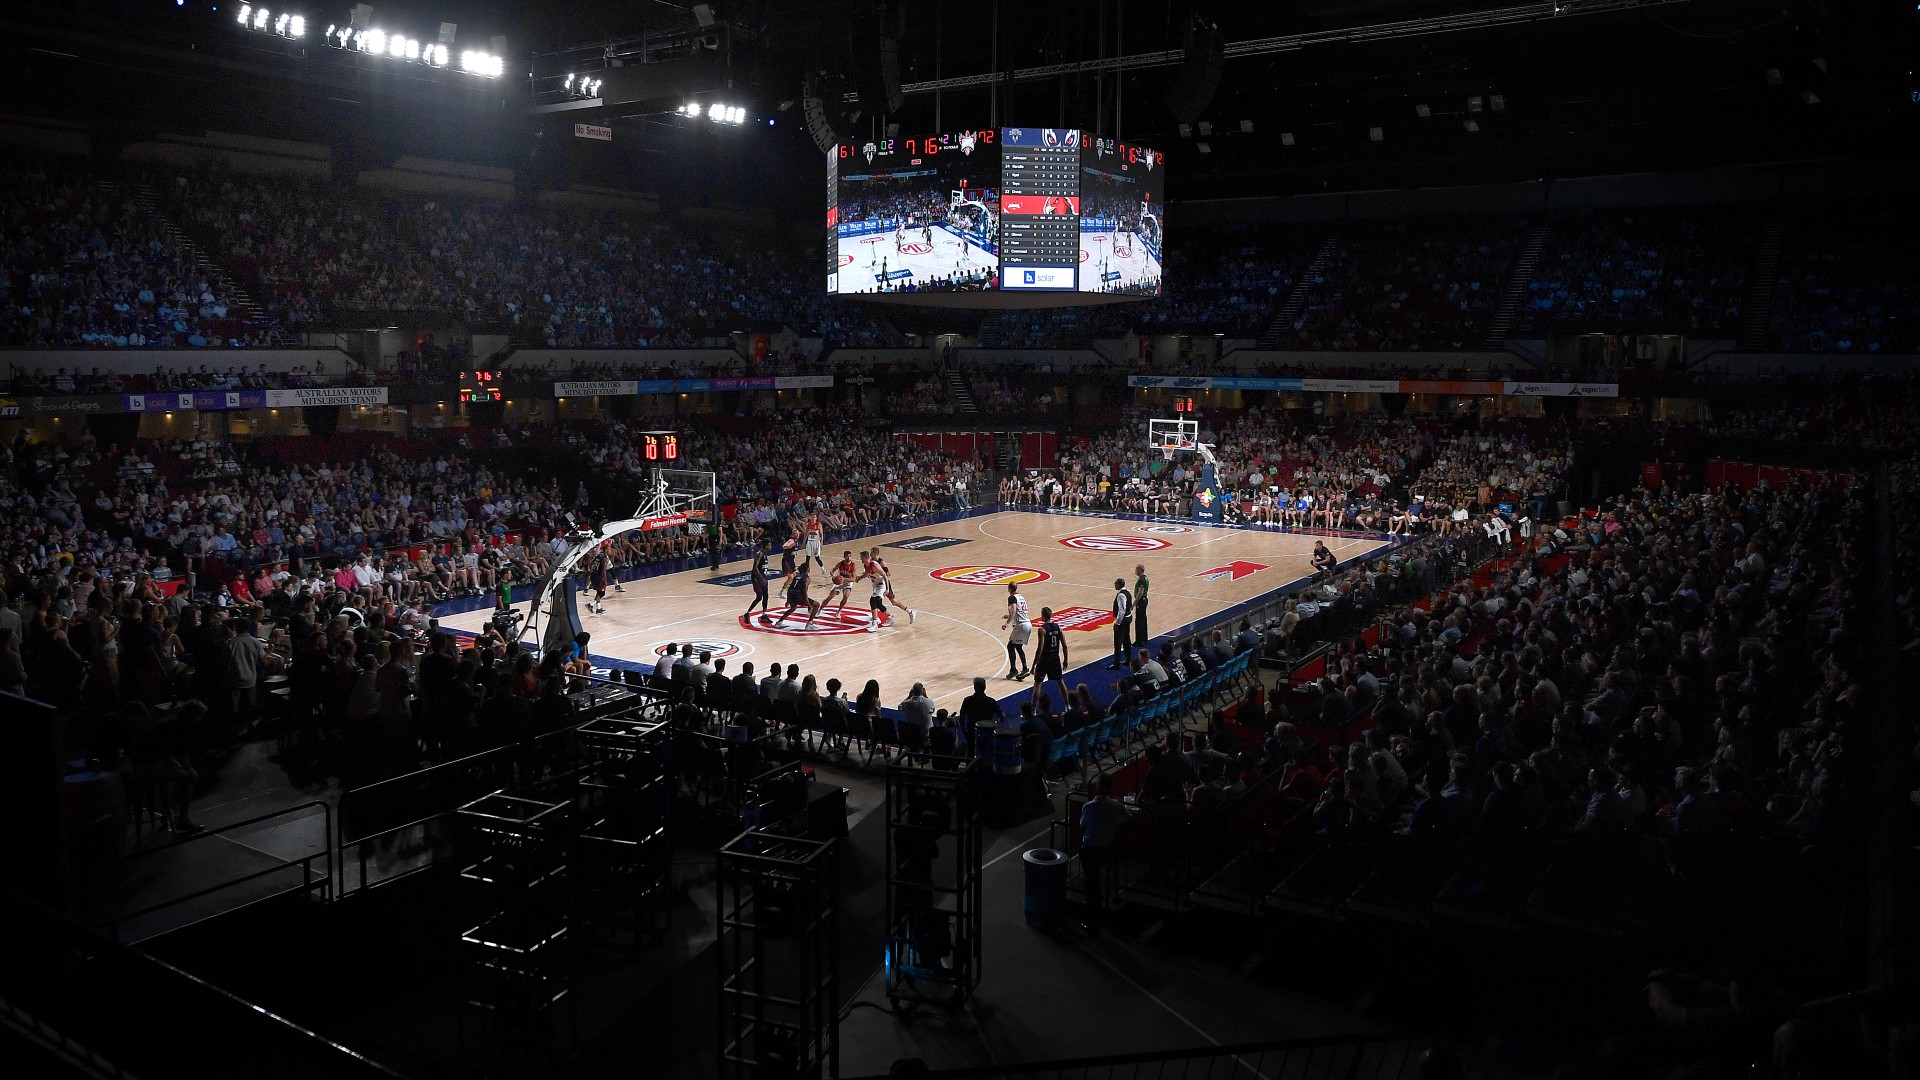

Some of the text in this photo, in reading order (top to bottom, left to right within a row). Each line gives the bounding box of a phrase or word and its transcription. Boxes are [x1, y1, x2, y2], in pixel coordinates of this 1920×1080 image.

[576, 125, 611, 140] No Smoking
[978, 130, 993, 144] 72
[906, 137, 938, 155] 7 16
[840, 146, 855, 158] 61
[1037, 273, 1055, 282] solar
[560, 381, 621, 391] AUSTRALIAN MOTORS
[598, 387, 618, 395] STAND
[294, 389, 348, 398] AUSTRALIAN
[350, 388, 382, 396] MOTORS
[300, 395, 377, 406] MITSUBISHI STAND
[646, 443, 677, 460] 10 10
[669, 516, 687, 526] Homes
